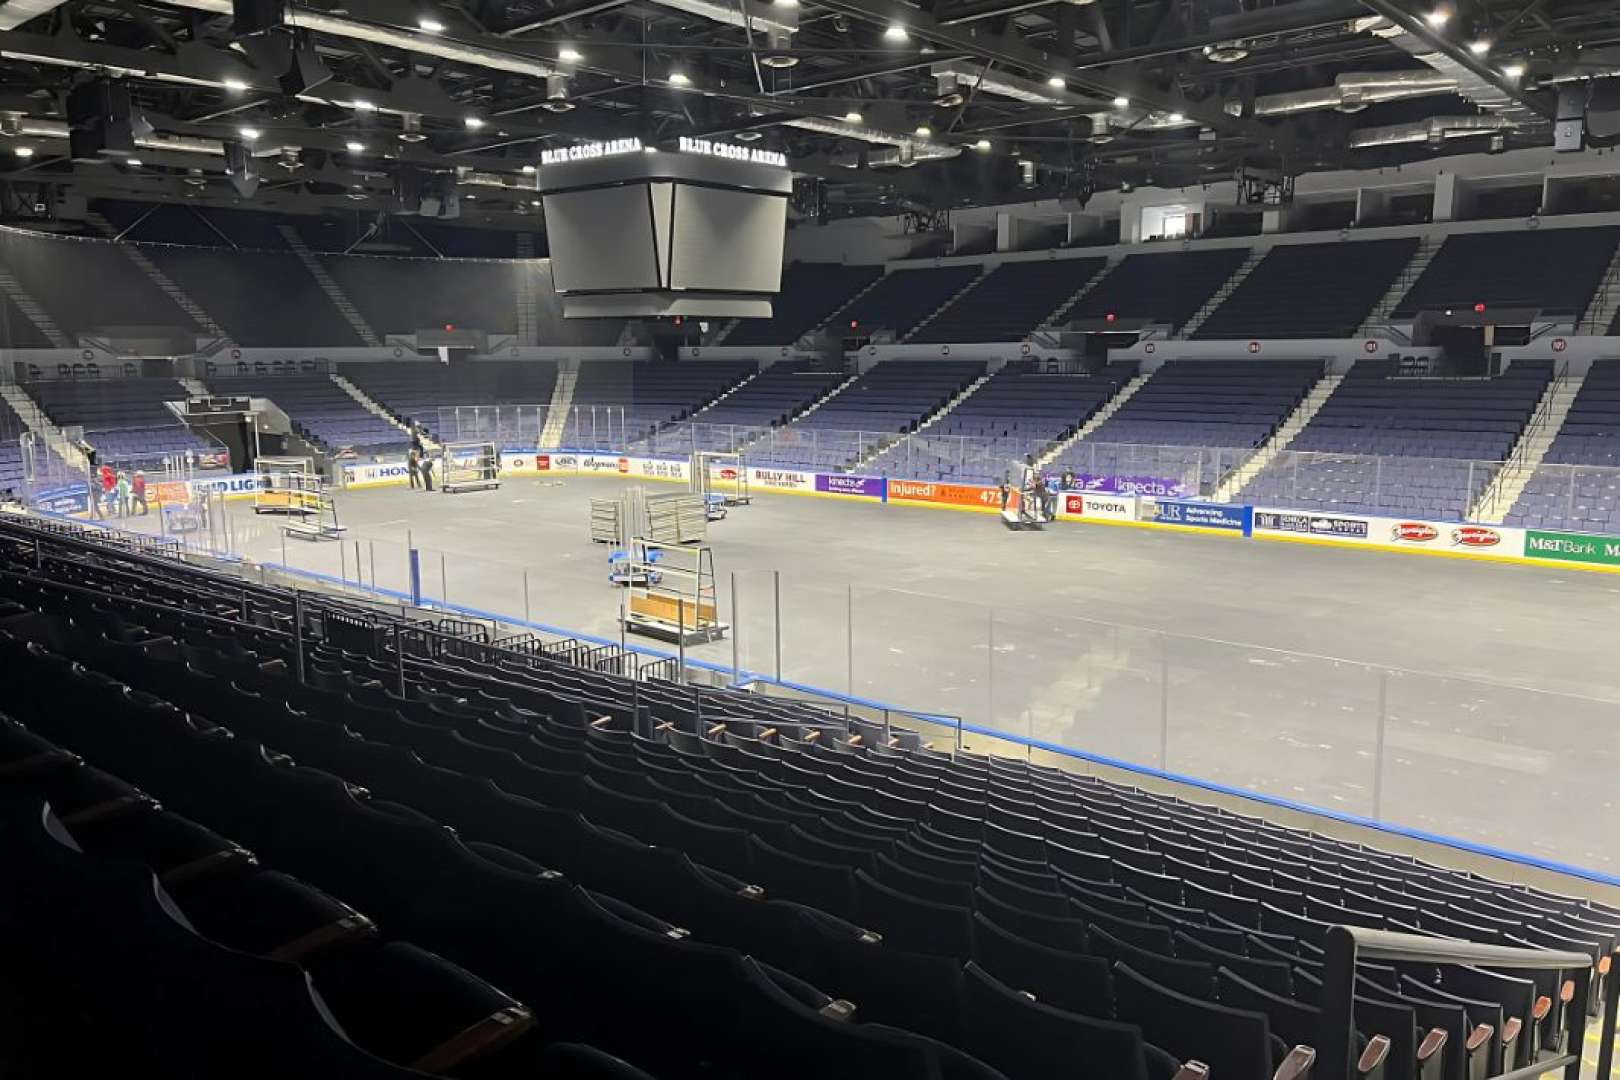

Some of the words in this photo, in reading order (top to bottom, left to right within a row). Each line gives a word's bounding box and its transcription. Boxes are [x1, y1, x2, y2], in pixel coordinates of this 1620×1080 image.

[569, 142, 604, 161] CROSS
[605, 136, 642, 156] ARENA
[679, 136, 712, 155] BLUE
[713, 142, 749, 161] CROSS
[750, 148, 787, 167] ARENA
[1086, 501, 1126, 513] TOYOTA
[1529, 536, 1562, 552] M&T
[1563, 539, 1596, 554] Bank
